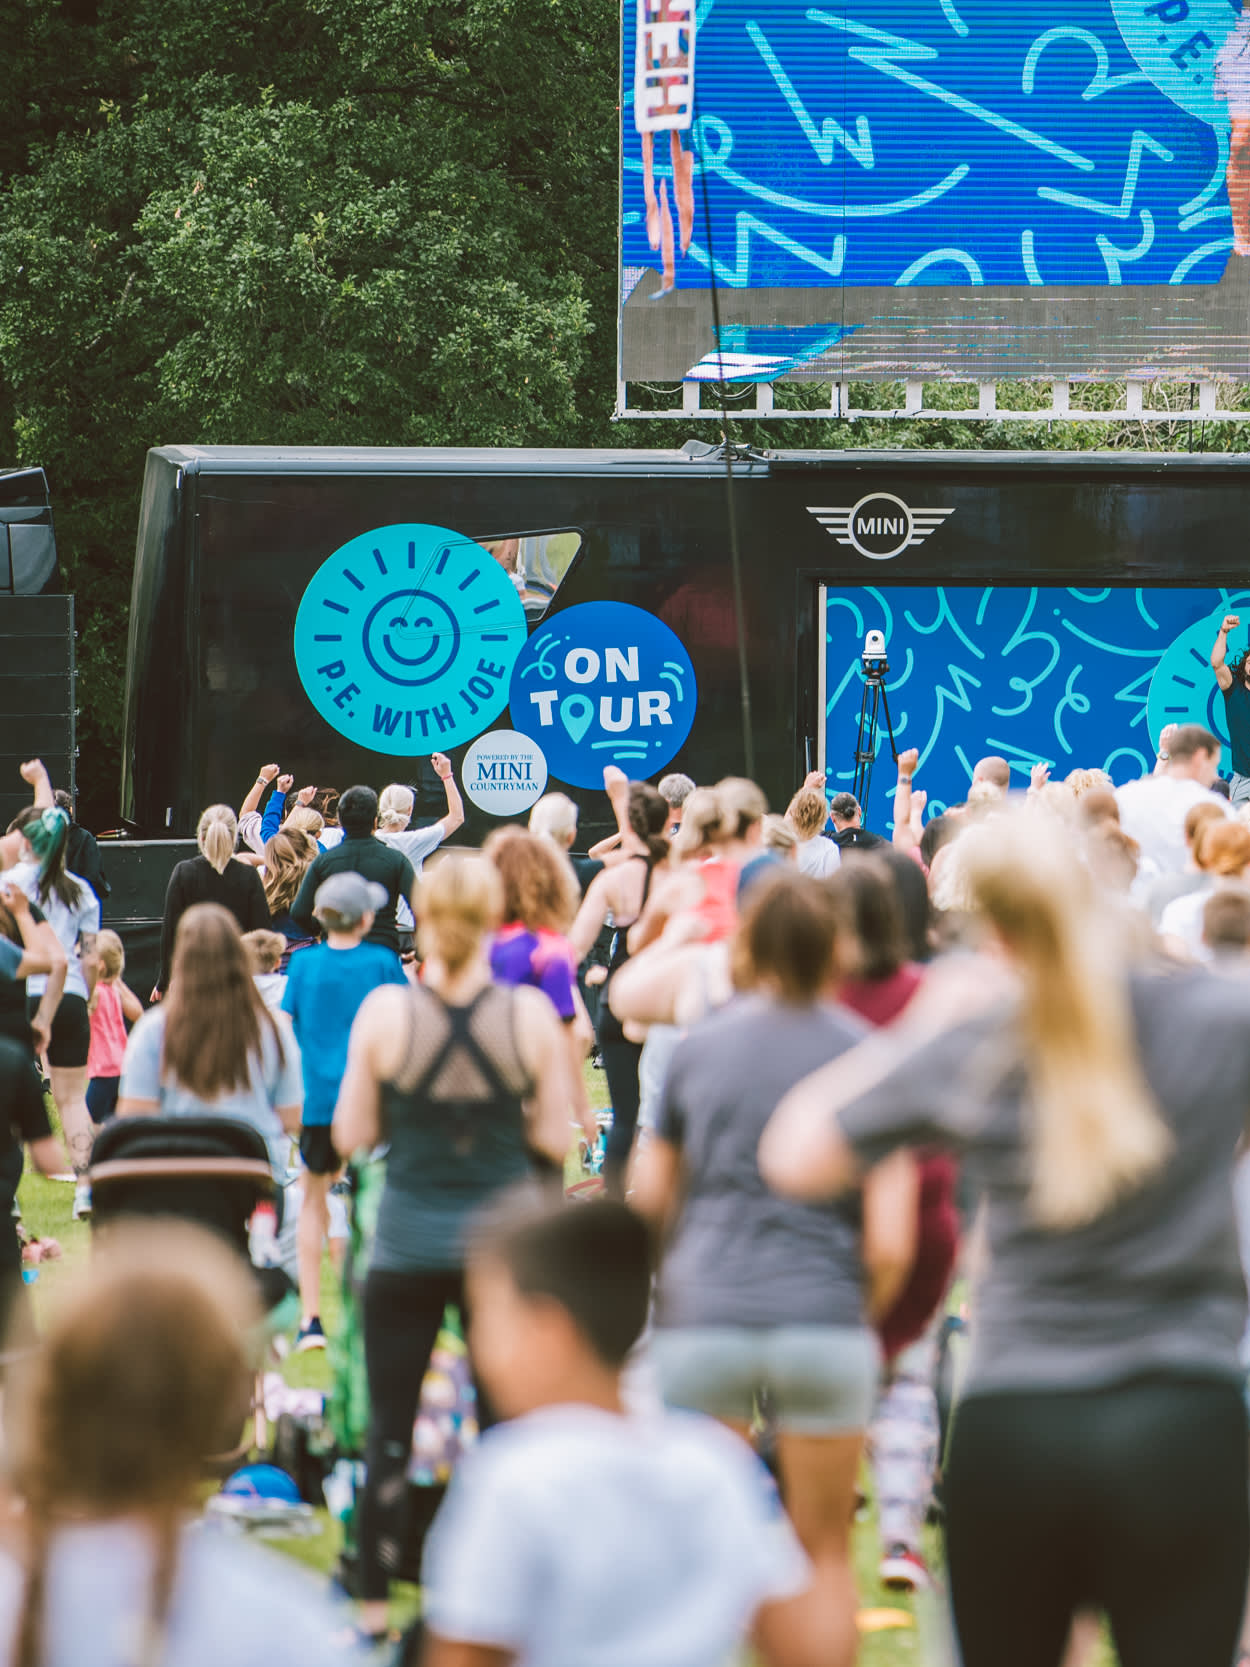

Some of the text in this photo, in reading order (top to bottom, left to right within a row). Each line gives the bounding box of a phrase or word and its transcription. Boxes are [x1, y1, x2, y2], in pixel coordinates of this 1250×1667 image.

[857, 517, 905, 535] MINI
[564, 646, 640, 684] ON
[317, 657, 506, 738] P.E. WITH JOE
[530, 690, 673, 744] TOUR
[477, 762, 532, 780] MINI
[470, 782, 539, 791] COUNTRYMAN
